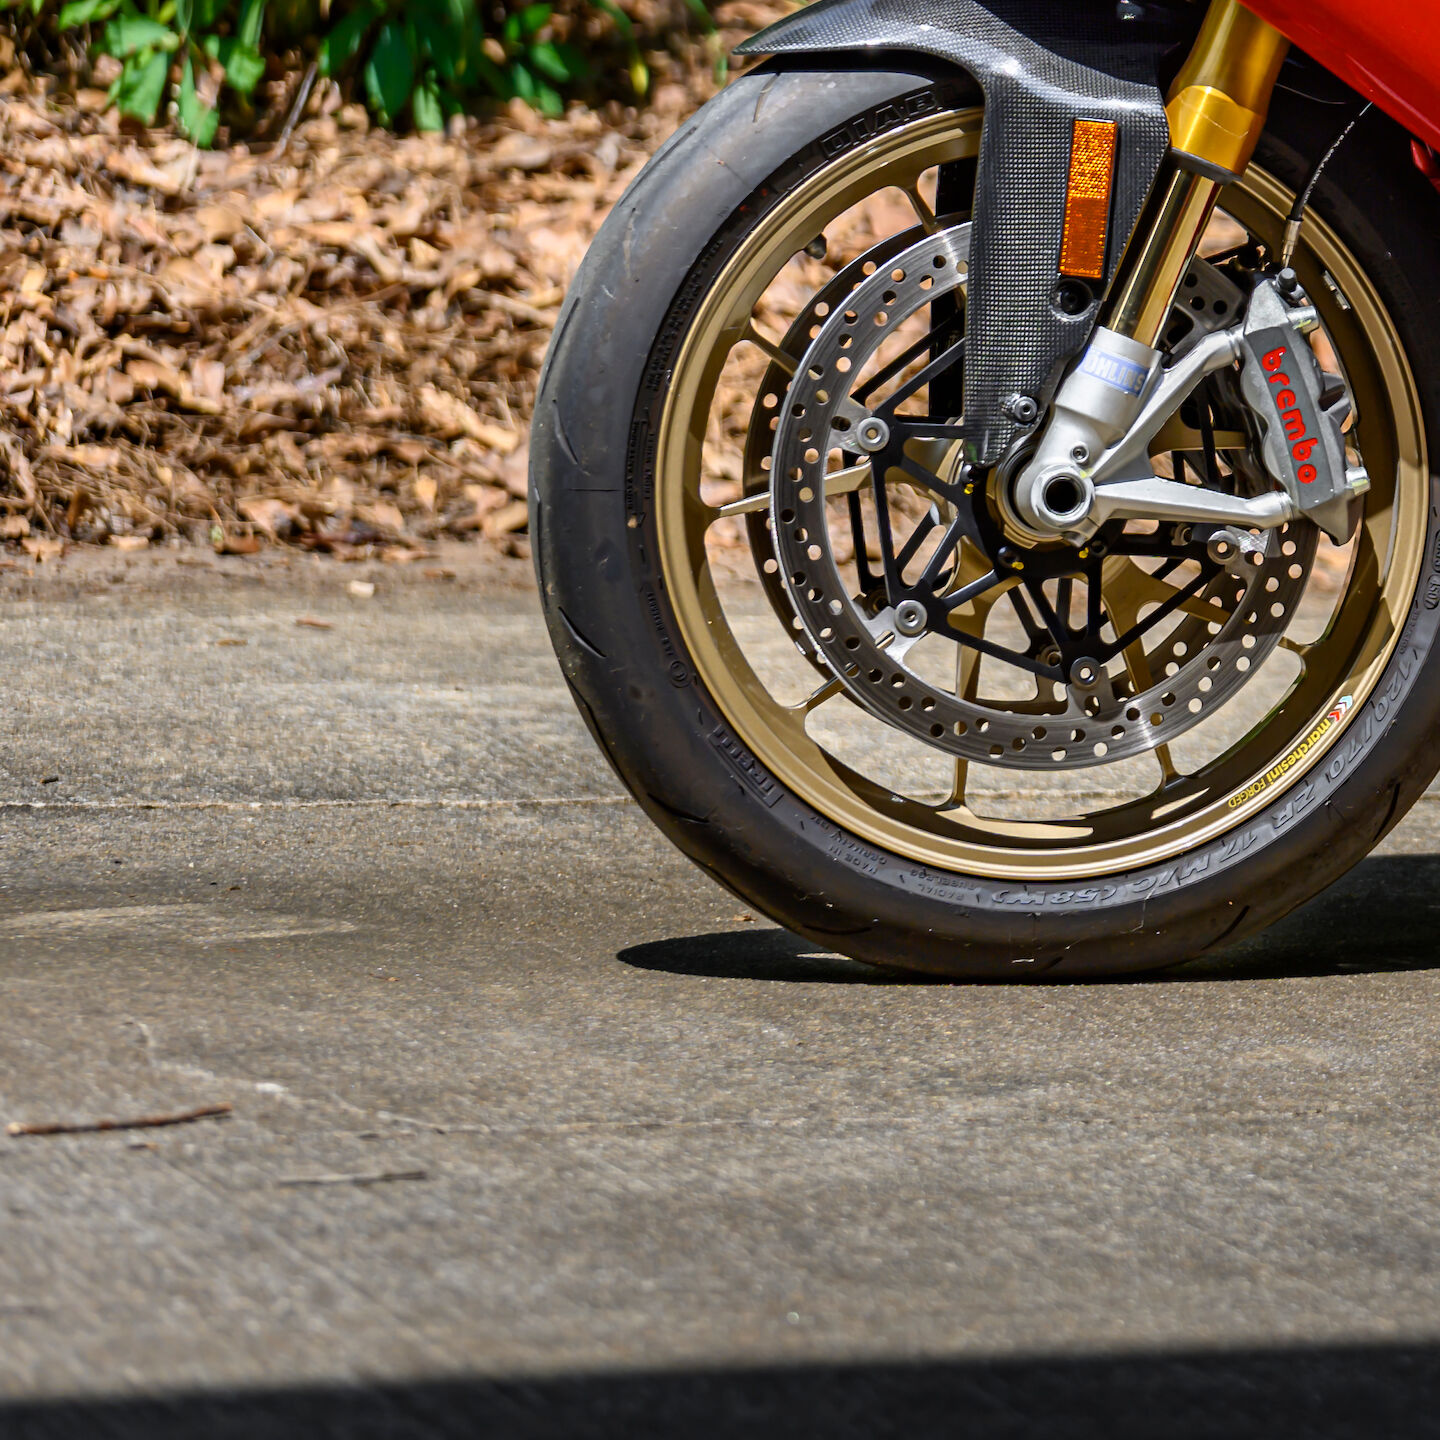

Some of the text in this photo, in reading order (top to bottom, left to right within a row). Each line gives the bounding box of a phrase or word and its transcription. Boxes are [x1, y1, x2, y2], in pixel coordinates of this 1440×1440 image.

[817, 88, 940, 157] DIAB
[1261, 346, 1319, 484] brembo
[1326, 658, 1416, 782] 120/70
[1227, 717, 1332, 809] marchesini FORGED
[1271, 781, 1318, 829] ZR
[1216, 831, 1258, 863] 17
